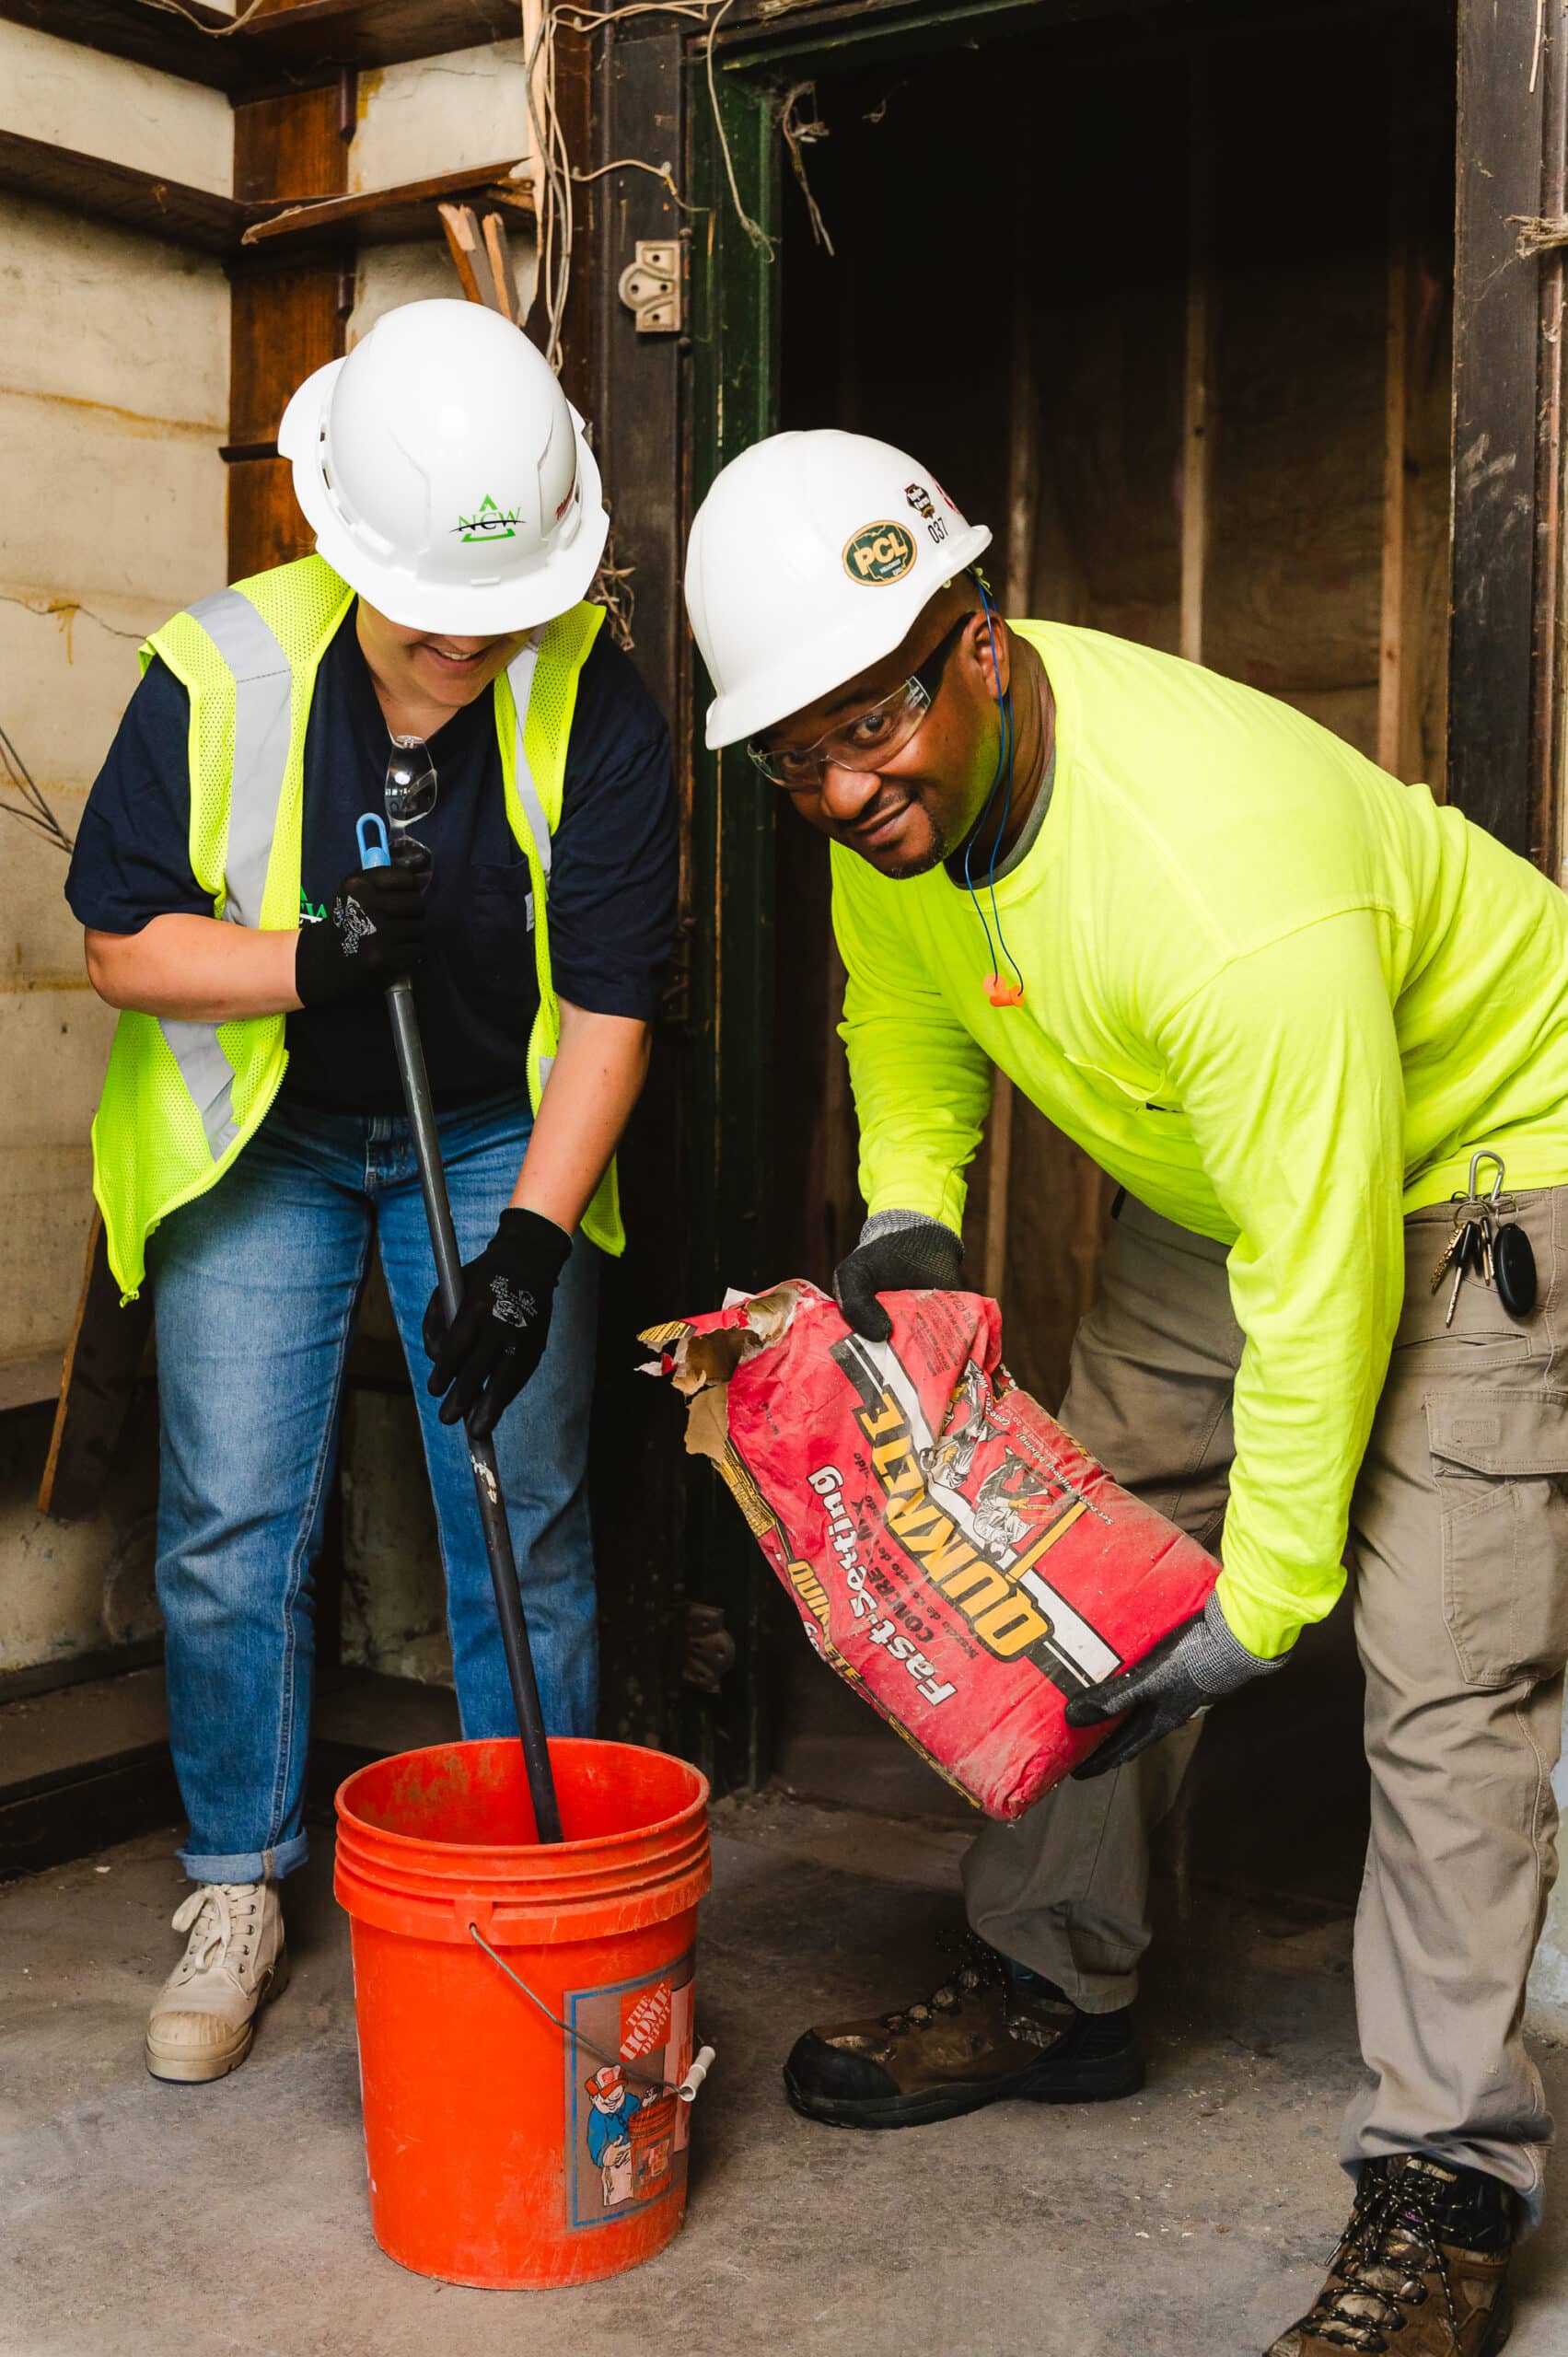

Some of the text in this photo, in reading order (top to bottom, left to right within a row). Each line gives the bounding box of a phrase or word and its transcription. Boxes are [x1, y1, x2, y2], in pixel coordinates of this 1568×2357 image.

[458, 506, 521, 532] NCW
[927, 517, 949, 544] 037
[853, 532, 908, 576] PCL
[1015, 1433, 1045, 1463] Mixing!
[859, 1393, 1049, 1658] QUIKRETE
[1095, 1510, 1114, 1526] Set
[877, 1546, 892, 1562] de
[807, 1465, 957, 1707] Fast-Setting
[865, 1548, 933, 1643] CONCRE
[924, 1605, 942, 1620] de
[620, 1980, 670, 2061] HOME
[625, 1994, 654, 2026] THE
[641, 2005, 670, 2055] DEPOT
